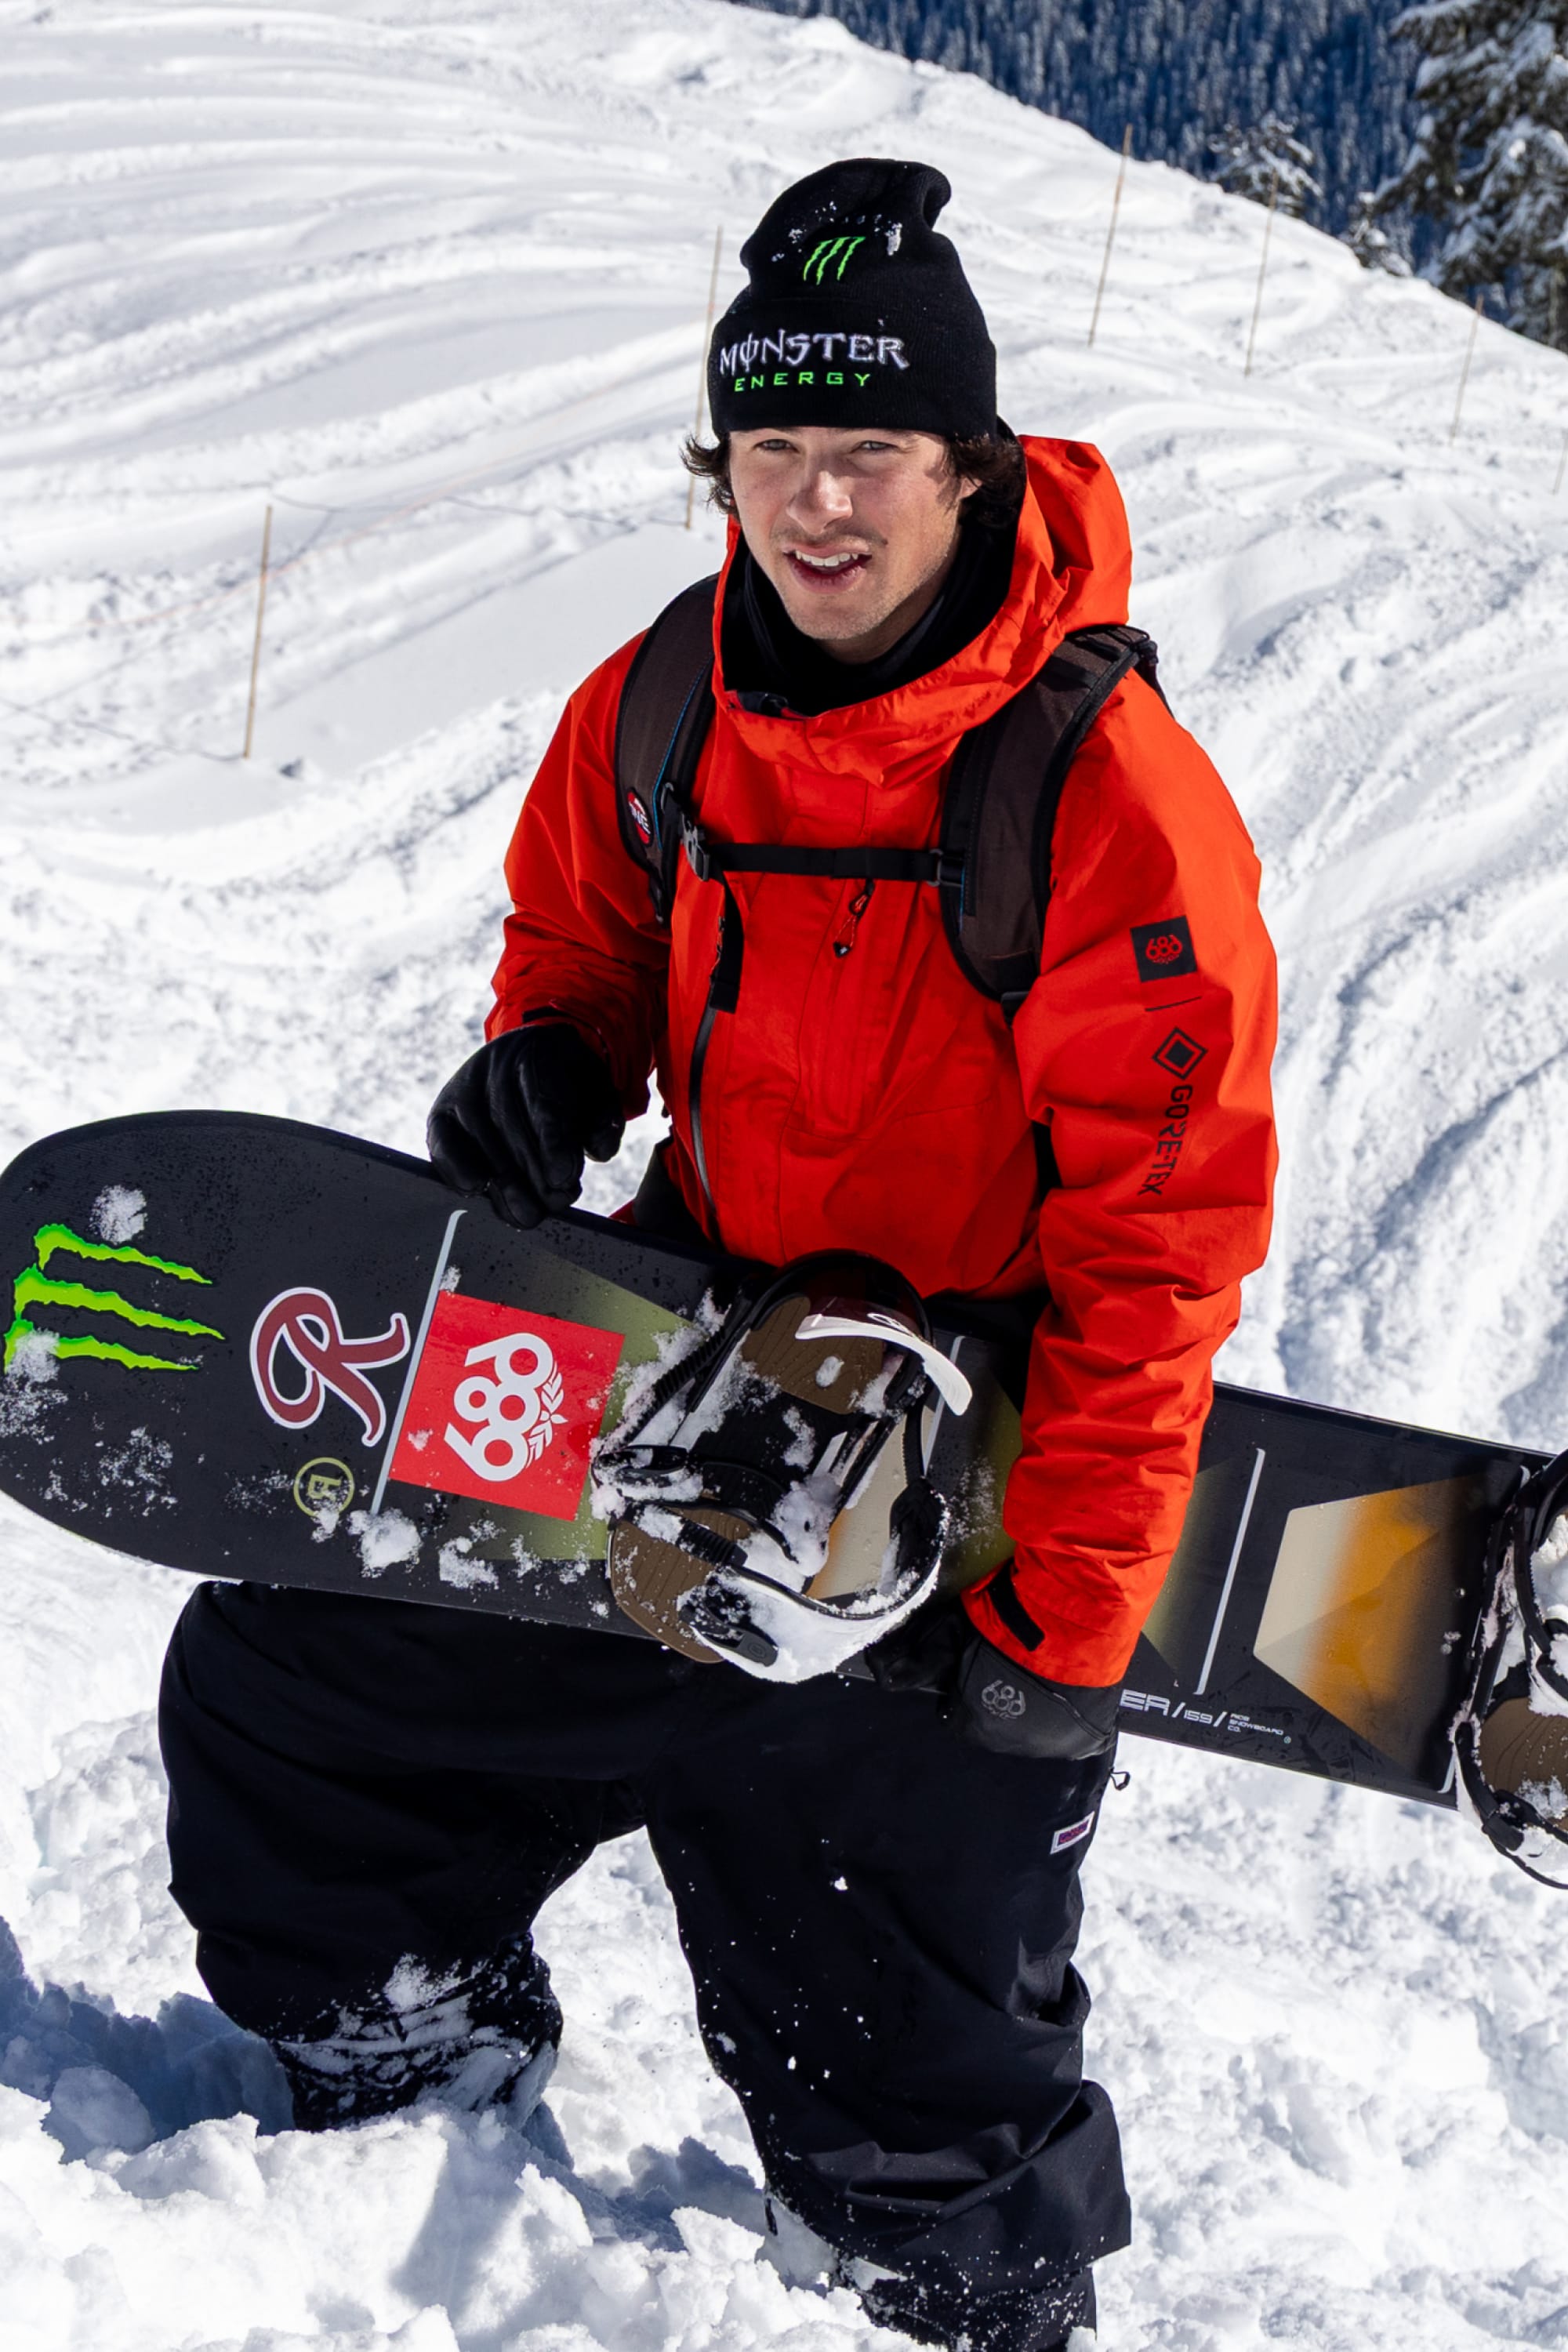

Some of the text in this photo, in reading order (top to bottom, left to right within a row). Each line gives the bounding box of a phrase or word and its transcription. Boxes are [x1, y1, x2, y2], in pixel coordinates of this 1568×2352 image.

[720, 328, 909, 376] MONSTER
[734, 372, 871, 392] ENERGY
[1145, 933, 1183, 961] 686
[1137, 1083, 1193, 1196] GORE-TEX
[443, 1332, 553, 1482] 686
[981, 1679, 1026, 1716] 686
